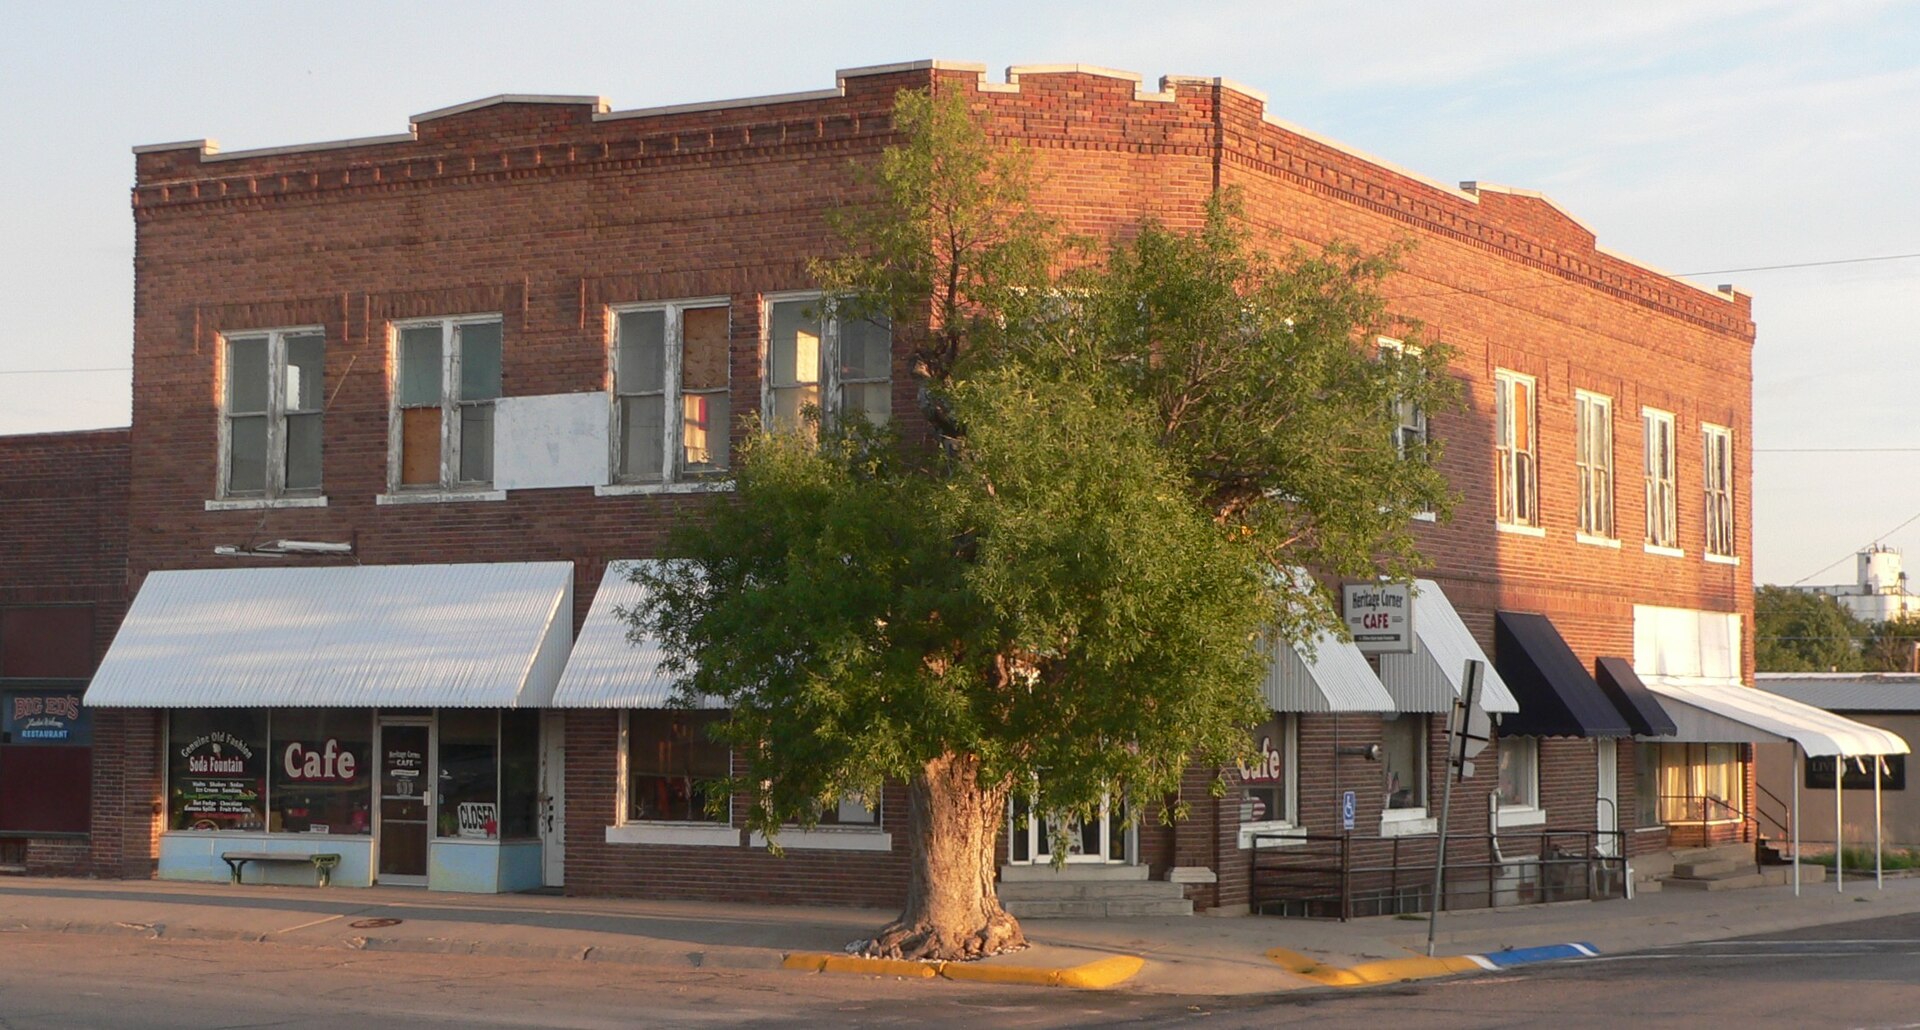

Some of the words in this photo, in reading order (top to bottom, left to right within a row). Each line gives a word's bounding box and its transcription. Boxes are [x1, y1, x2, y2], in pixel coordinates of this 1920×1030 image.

[1352, 588, 1380, 611] Heritage
[1381, 589, 1403, 608] Corner
[1363, 613, 1389, 629] CAFE
[13, 697, 43, 720] BIG
[46, 694, 79, 720] ED'S
[21, 729, 68, 738] RESTAURANT
[181, 735, 210, 758] Genuine
[211, 731, 226, 742] Old
[226, 733, 253, 760] Fashion
[190, 756, 207, 772] Soda
[210, 756, 243, 772] Fountain
[284, 738, 355, 779] Cafe
[460, 805, 496, 829] CLOSED
